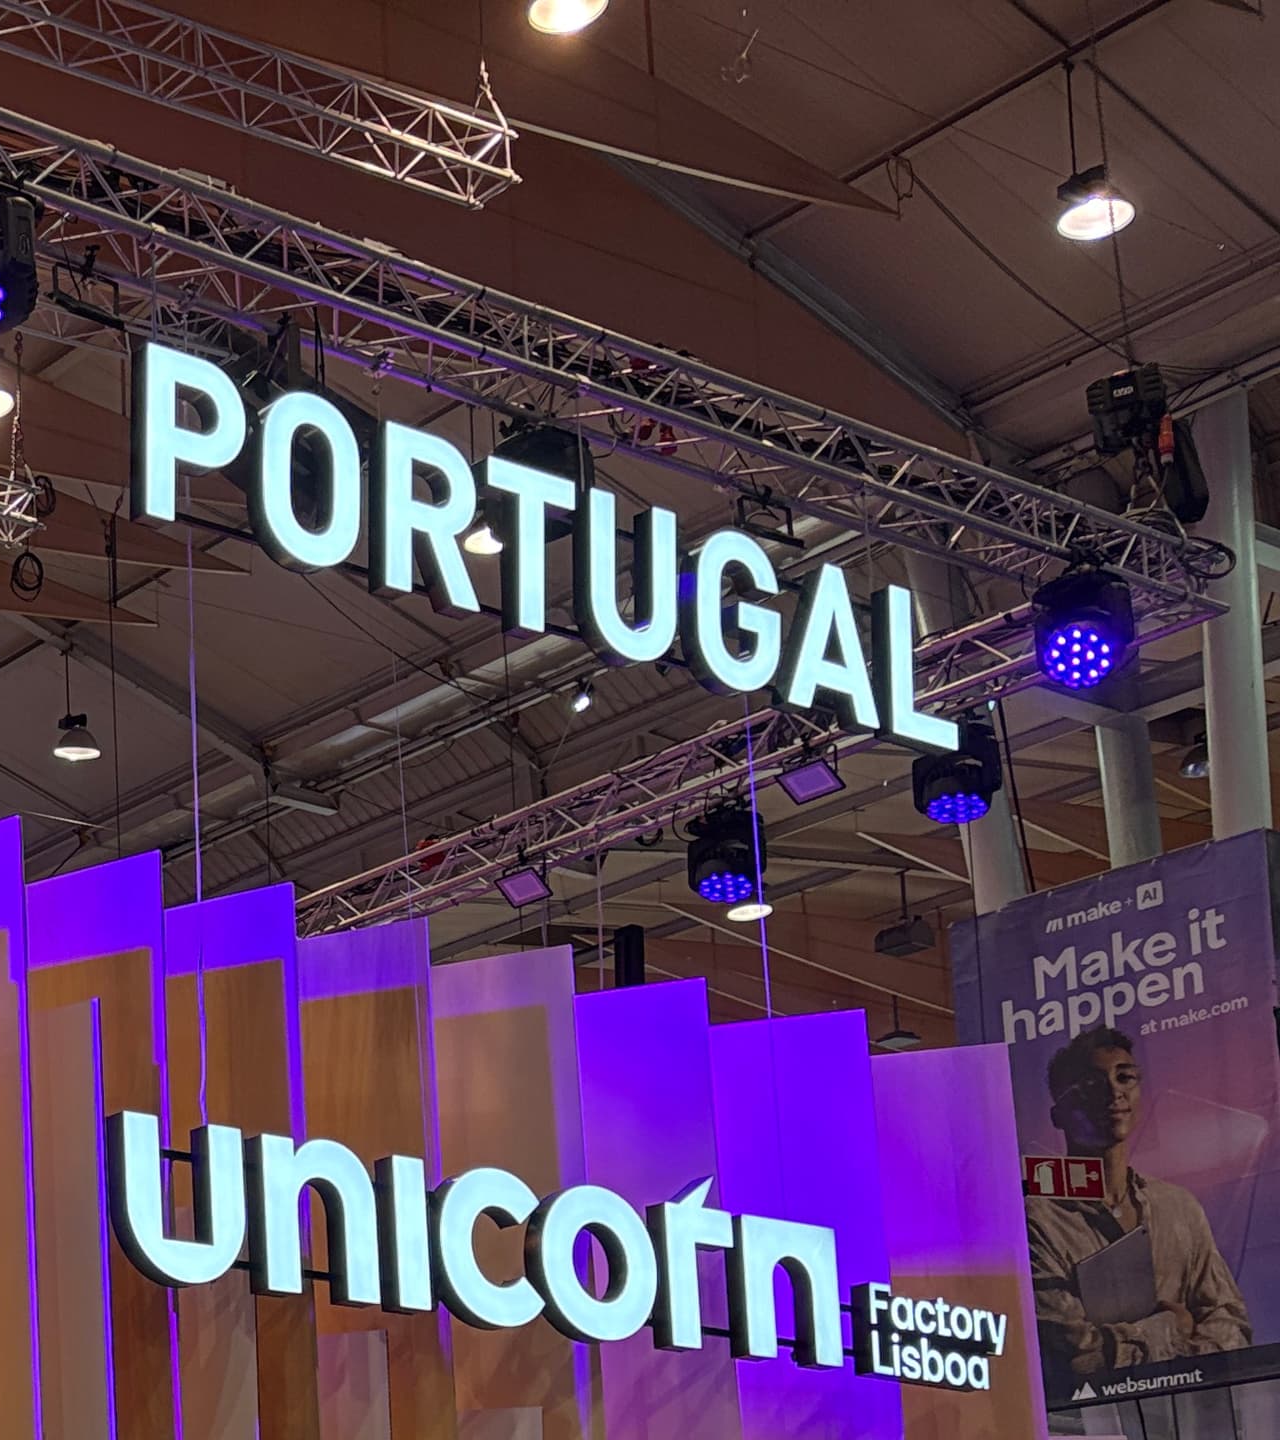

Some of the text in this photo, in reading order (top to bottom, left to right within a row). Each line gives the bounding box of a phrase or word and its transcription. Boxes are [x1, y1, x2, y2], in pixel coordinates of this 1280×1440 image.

[143, 341, 960, 752] PORTUGAL
[1066, 900, 1122, 928] make
[1033, 907, 1228, 1000] Make it
[1001, 961, 1205, 1045] happen
[1140, 996, 1249, 1036] at make.com
[117, 1110, 844, 1368] unicorn
[869, 1281, 1007, 1356] Factory
[872, 1330, 990, 1390] Lisboa
[1102, 1368, 1203, 1396] websummit
